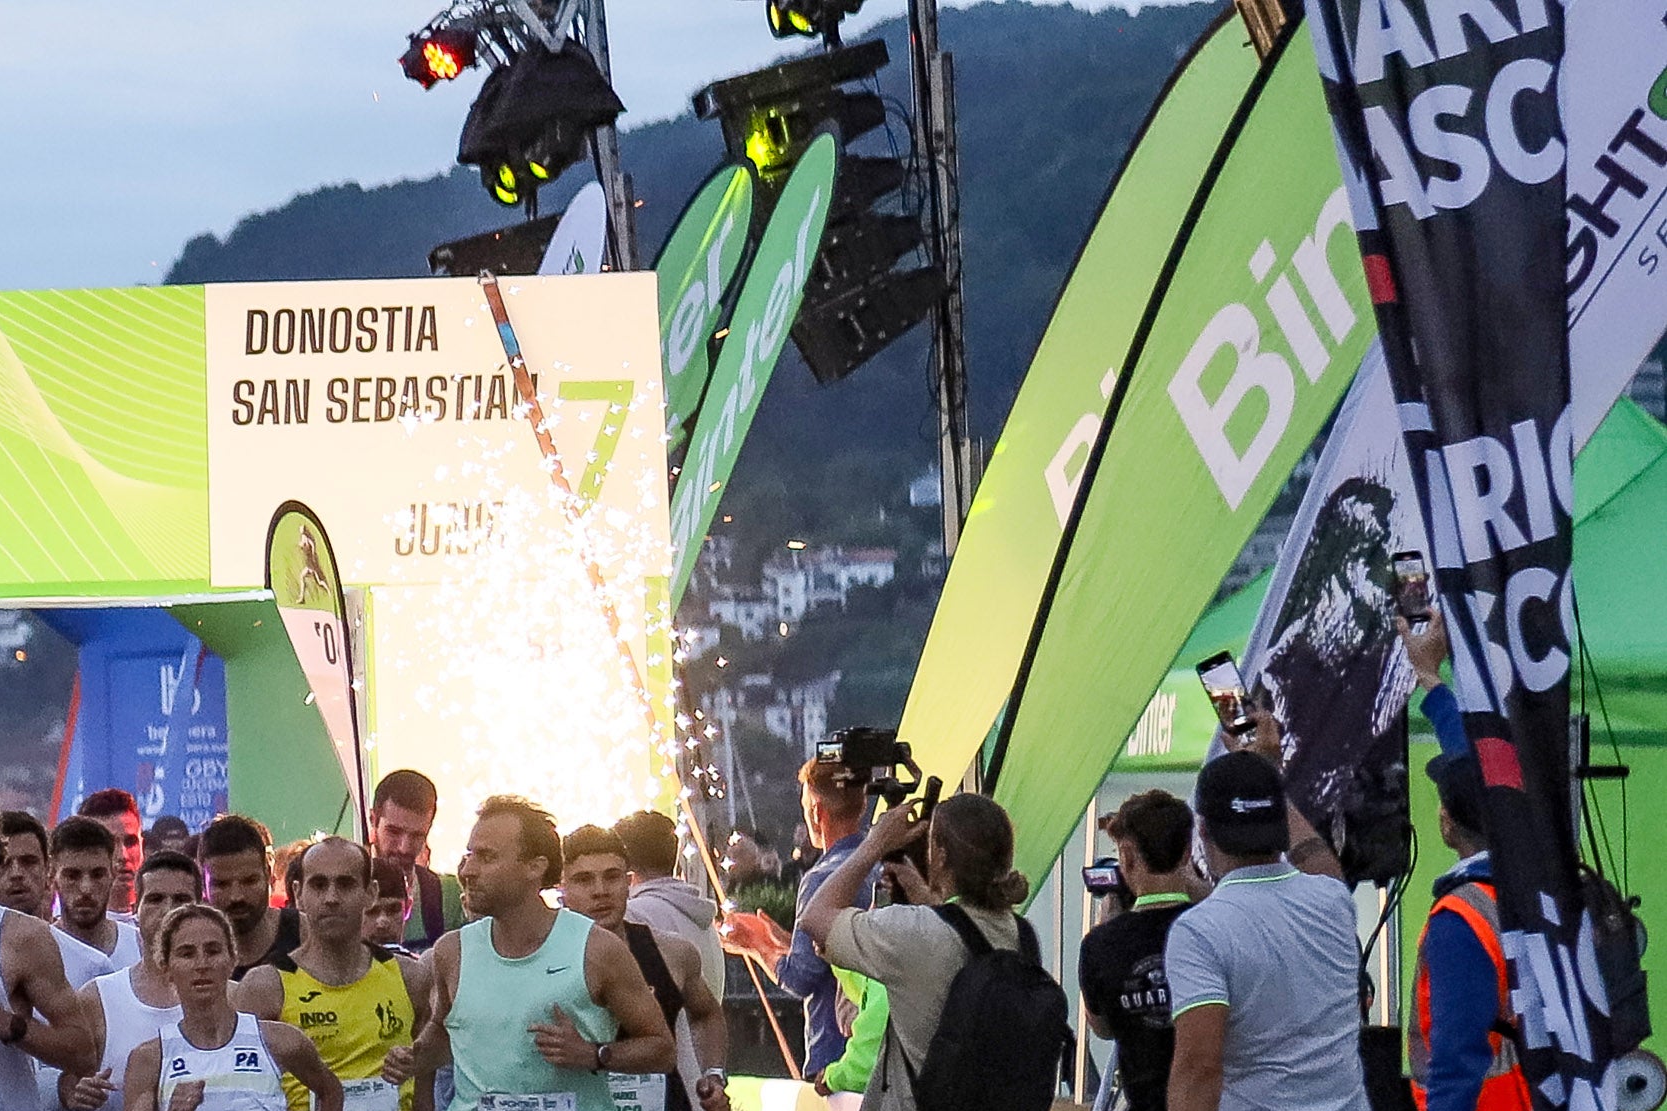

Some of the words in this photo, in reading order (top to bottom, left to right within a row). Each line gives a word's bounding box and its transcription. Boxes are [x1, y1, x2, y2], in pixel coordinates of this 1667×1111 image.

[245, 305, 439, 355] DONOSTIA
[232, 378, 310, 426] SAN
[559, 380, 634, 530] 7
[300, 1012, 337, 1025] INDO
[235, 1052, 259, 1067] PA
